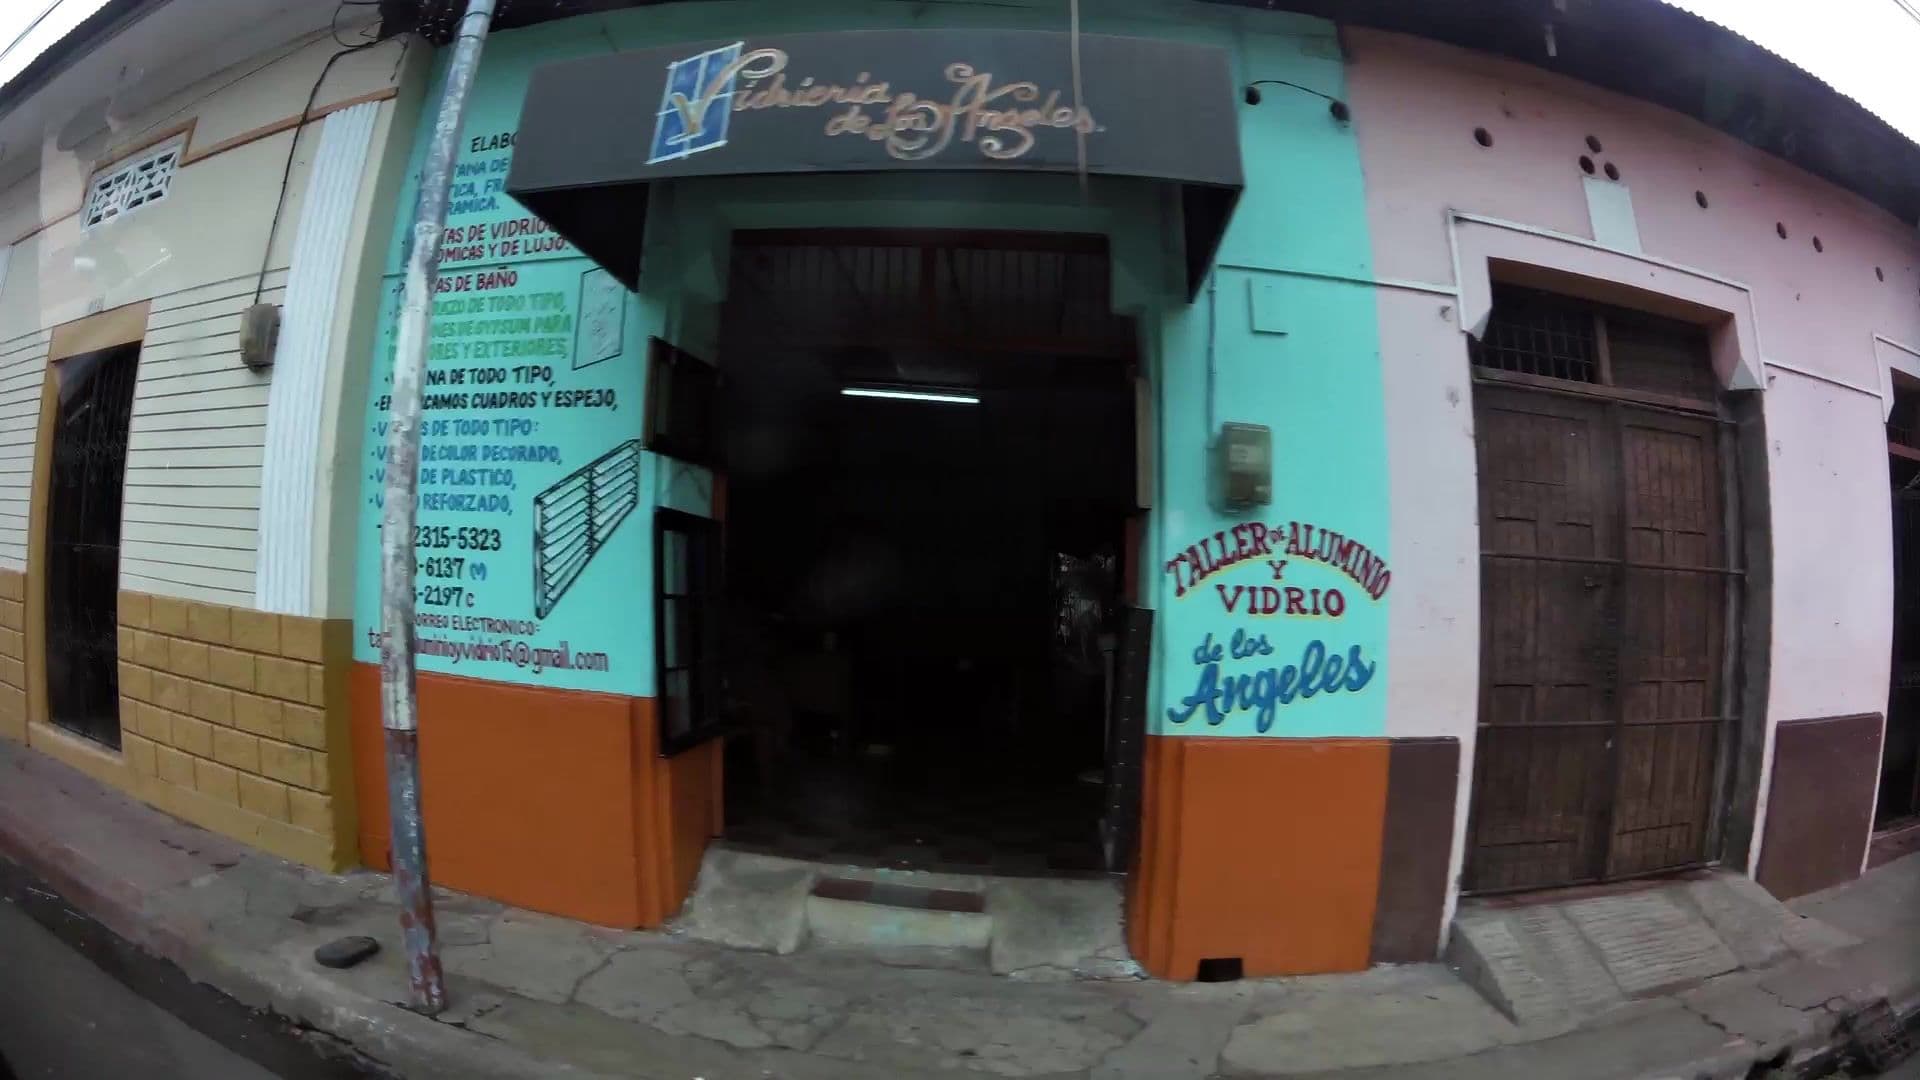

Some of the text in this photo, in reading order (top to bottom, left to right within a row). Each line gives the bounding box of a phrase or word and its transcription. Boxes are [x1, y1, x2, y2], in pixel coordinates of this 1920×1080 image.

[488, 158, 509, 174] DE
[468, 223, 486, 242] DE
[488, 243, 498, 258] Y
[500, 240, 520, 257] DE
[454, 275, 473, 293] DE
[468, 296, 485, 314] DE
[487, 294, 525, 312] TODO
[449, 368, 466, 385] DE
[468, 367, 508, 385] TODO
[471, 390, 538, 410] CUADROS
[541, 390, 552, 408] Y
[431, 420, 449, 437] DE
[452, 418, 490, 437] TODO
[421, 444, 438, 462] DE
[420, 468, 437, 485] DE
[1165, 521, 1272, 598] TALLER
[1284, 520, 1392, 601] ALUMINIO
[1266, 560, 1288, 580] Y
[1216, 584, 1346, 617] VIDRIO
[1193, 627, 1275, 665] de los
[1166, 639, 1377, 734] Angeles
